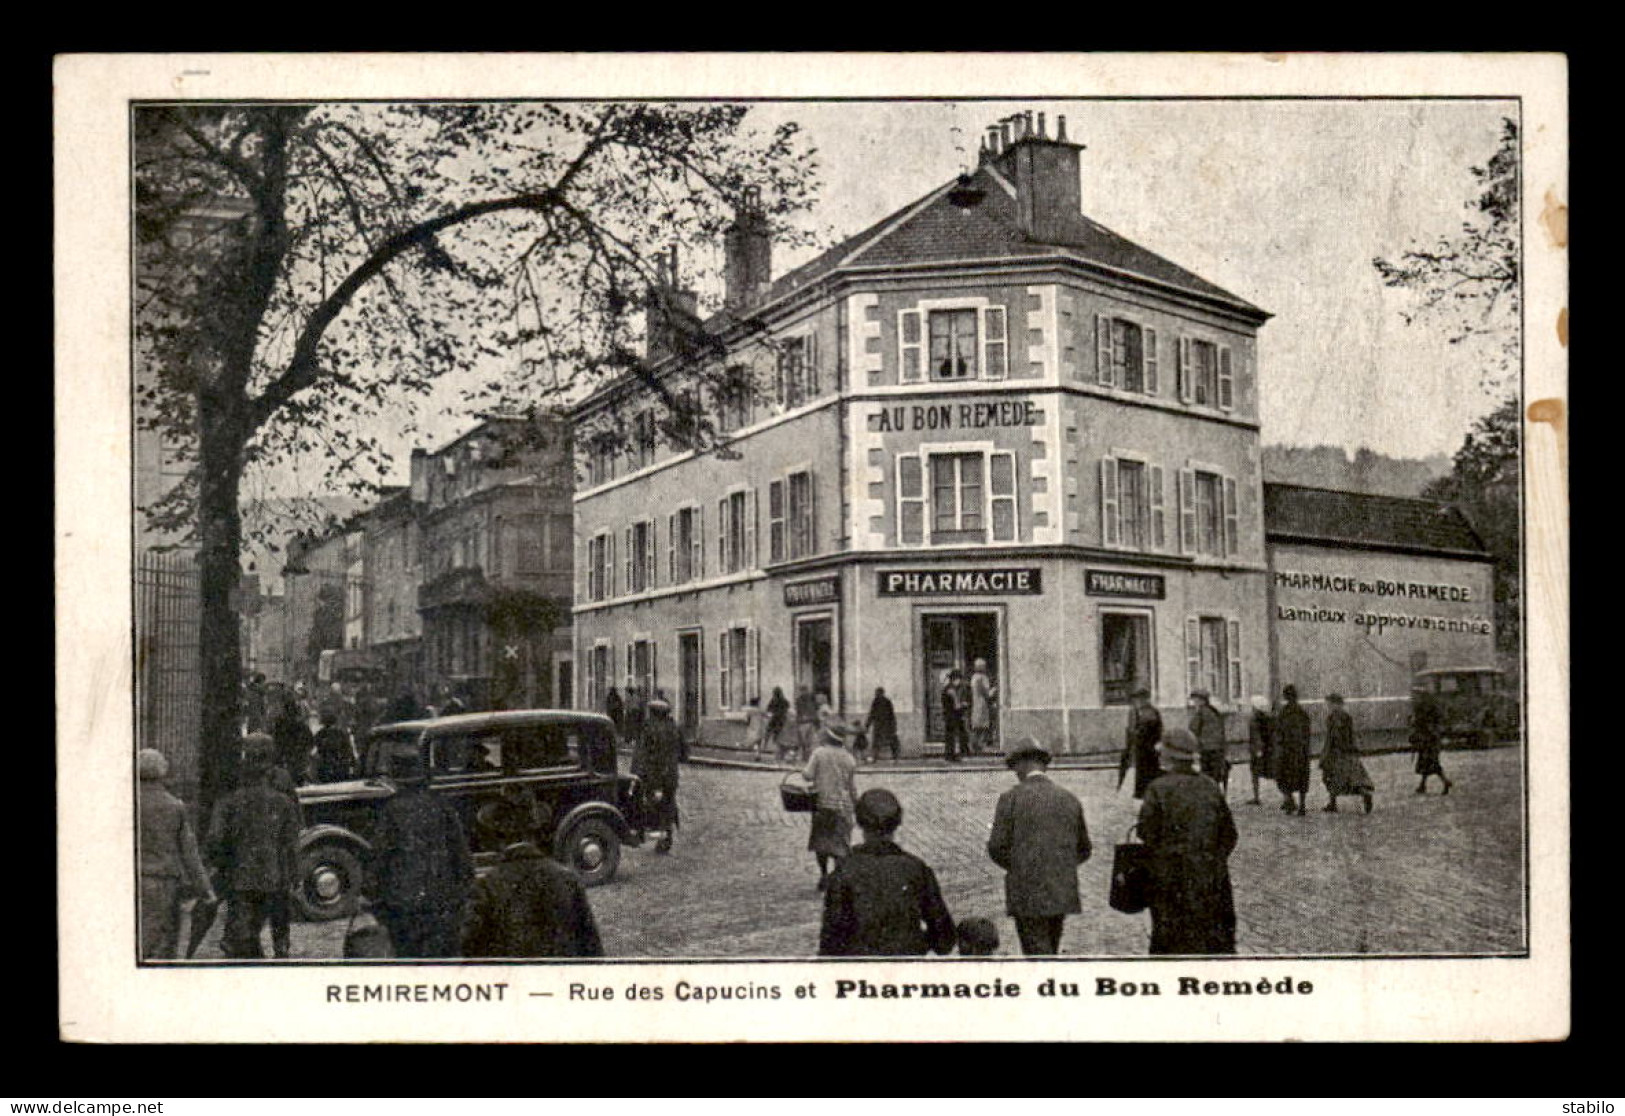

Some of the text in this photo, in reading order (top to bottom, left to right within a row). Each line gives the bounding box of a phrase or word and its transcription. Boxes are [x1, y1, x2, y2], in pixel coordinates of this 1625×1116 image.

[879, 407, 905, 432] AU
[912, 404, 952, 431] BON
[888, 571, 1030, 592] PHARMACIE
[1274, 572, 1356, 594] PHARMACIE
[326, 984, 509, 1002] REMIREMONT
[569, 983, 614, 1000] Rue
[625, 983, 664, 1000] des
[675, 981, 782, 1003] Capucins
[795, 982, 817, 999] et
[835, 979, 1021, 999] Pharmacie
[1037, 978, 1080, 997] du
[1095, 978, 1161, 996] Bon
[1178, 976, 1314, 996] Remède
